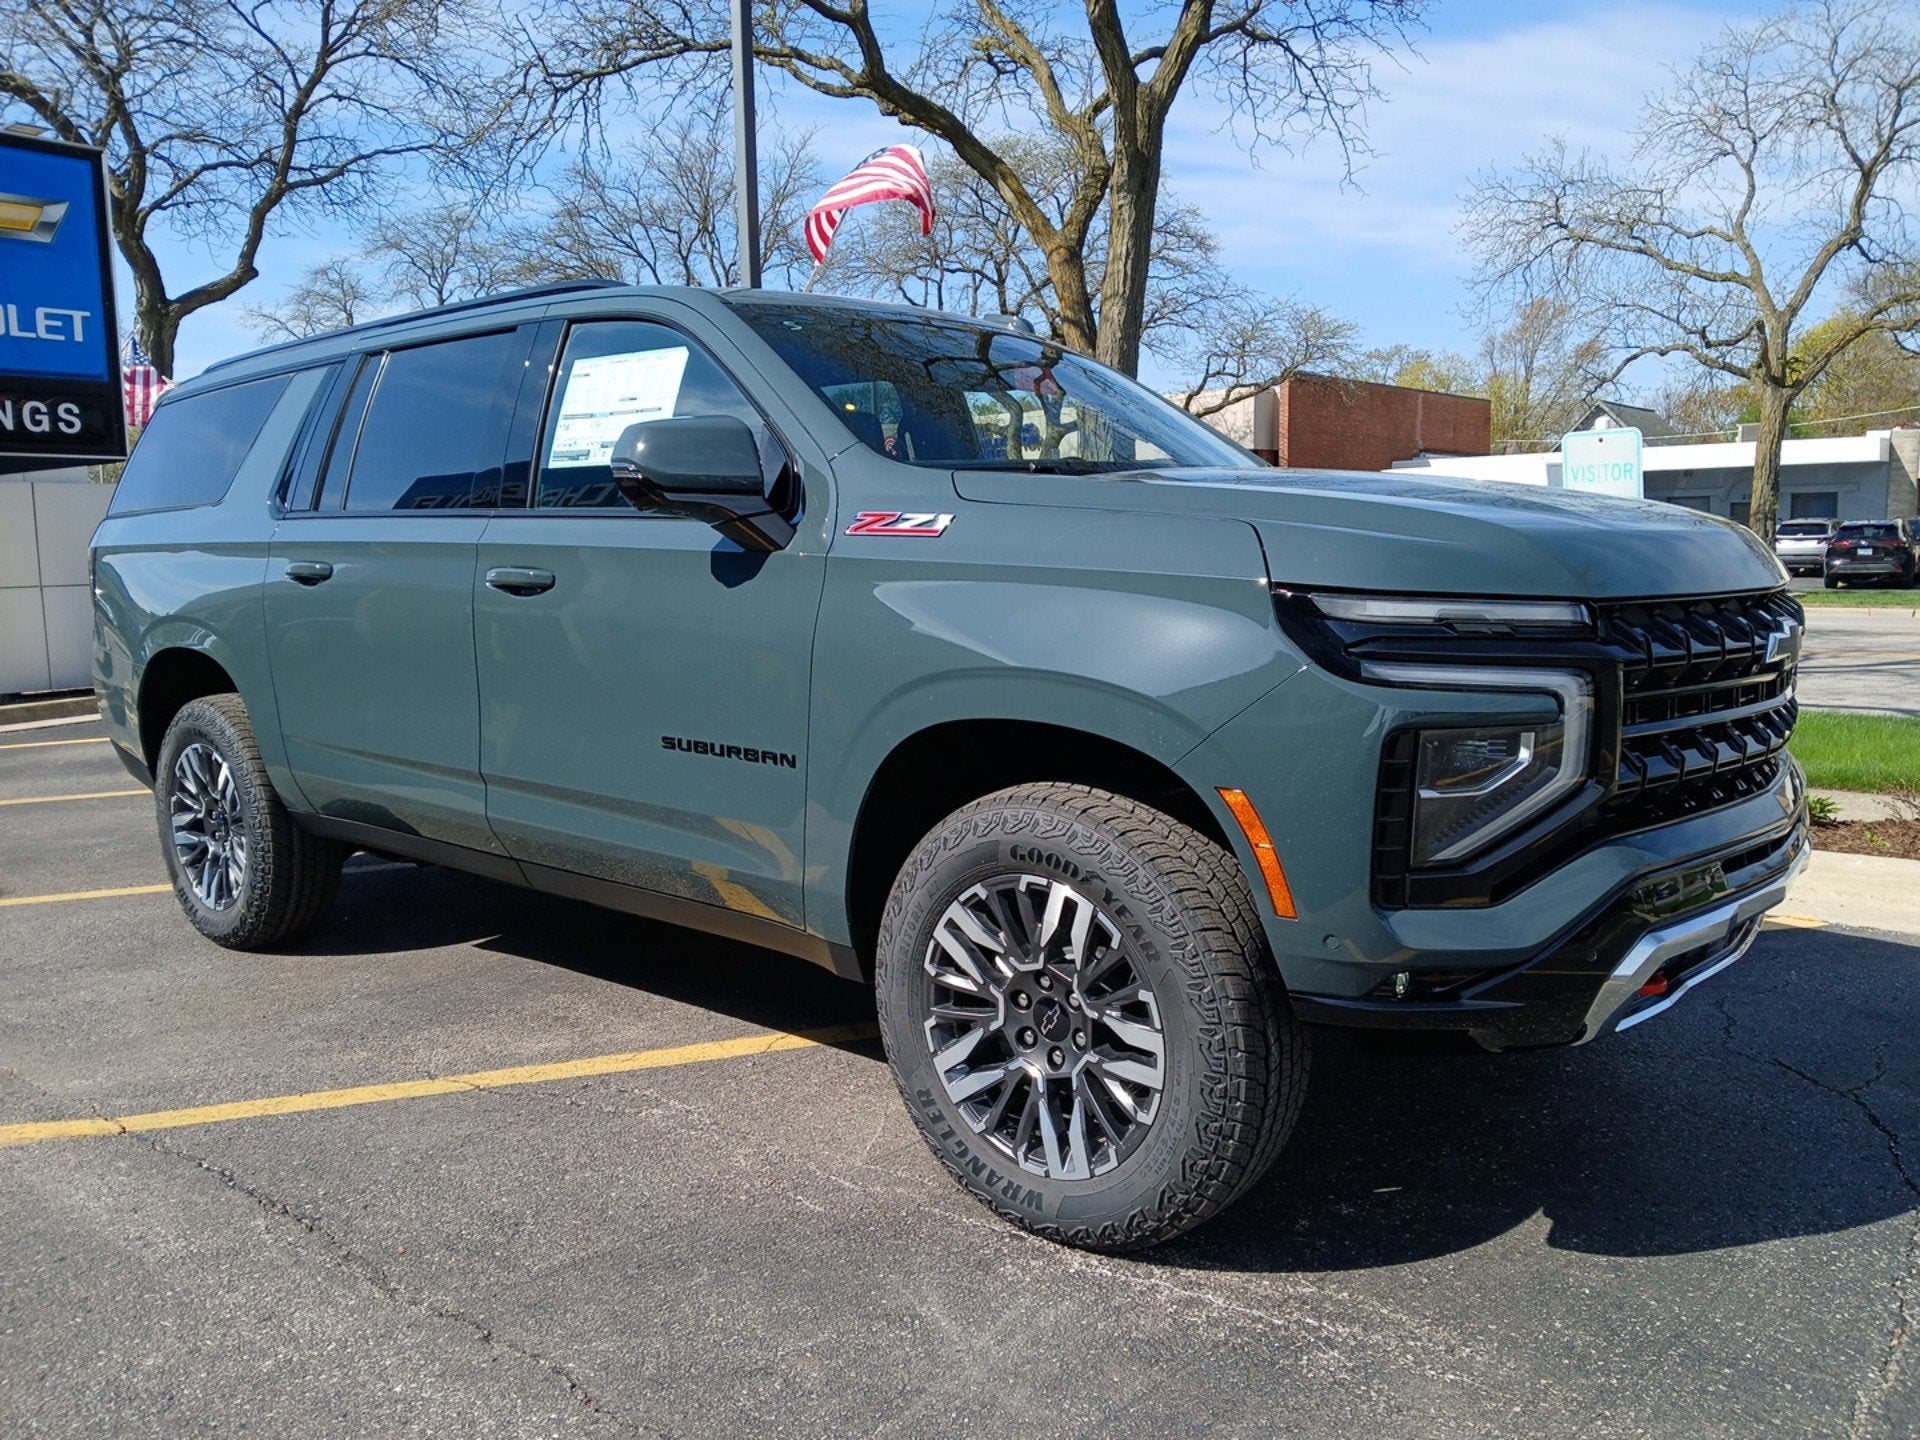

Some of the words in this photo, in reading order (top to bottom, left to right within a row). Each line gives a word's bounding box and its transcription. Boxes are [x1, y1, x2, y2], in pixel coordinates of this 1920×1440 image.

[0, 303, 91, 342] LET
[1571, 462, 1634, 482] VISITOR
[844, 511, 956, 537] Z71
[661, 736, 796, 769] SUBURBAN
[916, 1088, 1044, 1212] WRANGLER
